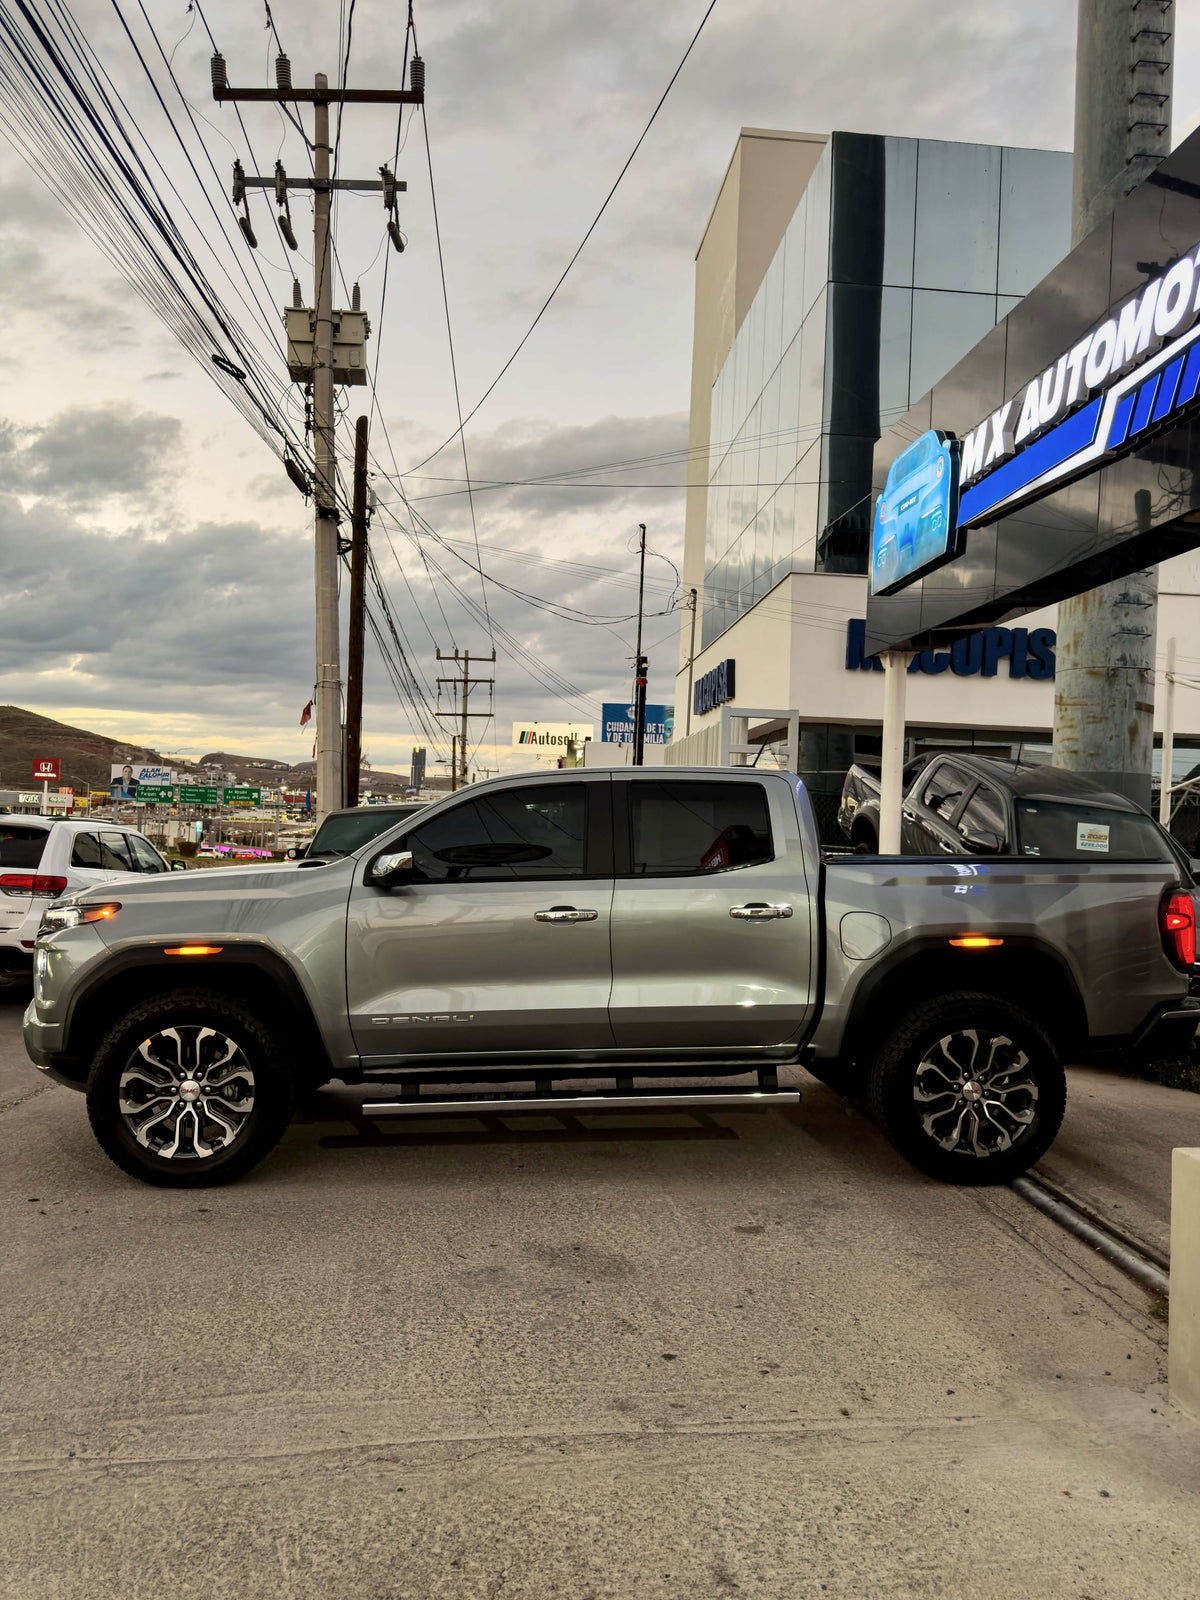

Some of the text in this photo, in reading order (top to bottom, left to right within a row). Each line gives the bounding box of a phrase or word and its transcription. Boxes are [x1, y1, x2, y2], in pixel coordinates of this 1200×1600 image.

[959, 242, 1200, 487] MX AUTOMO
[646, 723, 657, 733] DE
[658, 723, 665, 734] TI
[606, 732, 664, 744] Y DE TU MILIA
[371, 1014, 474, 1025] DENALI
